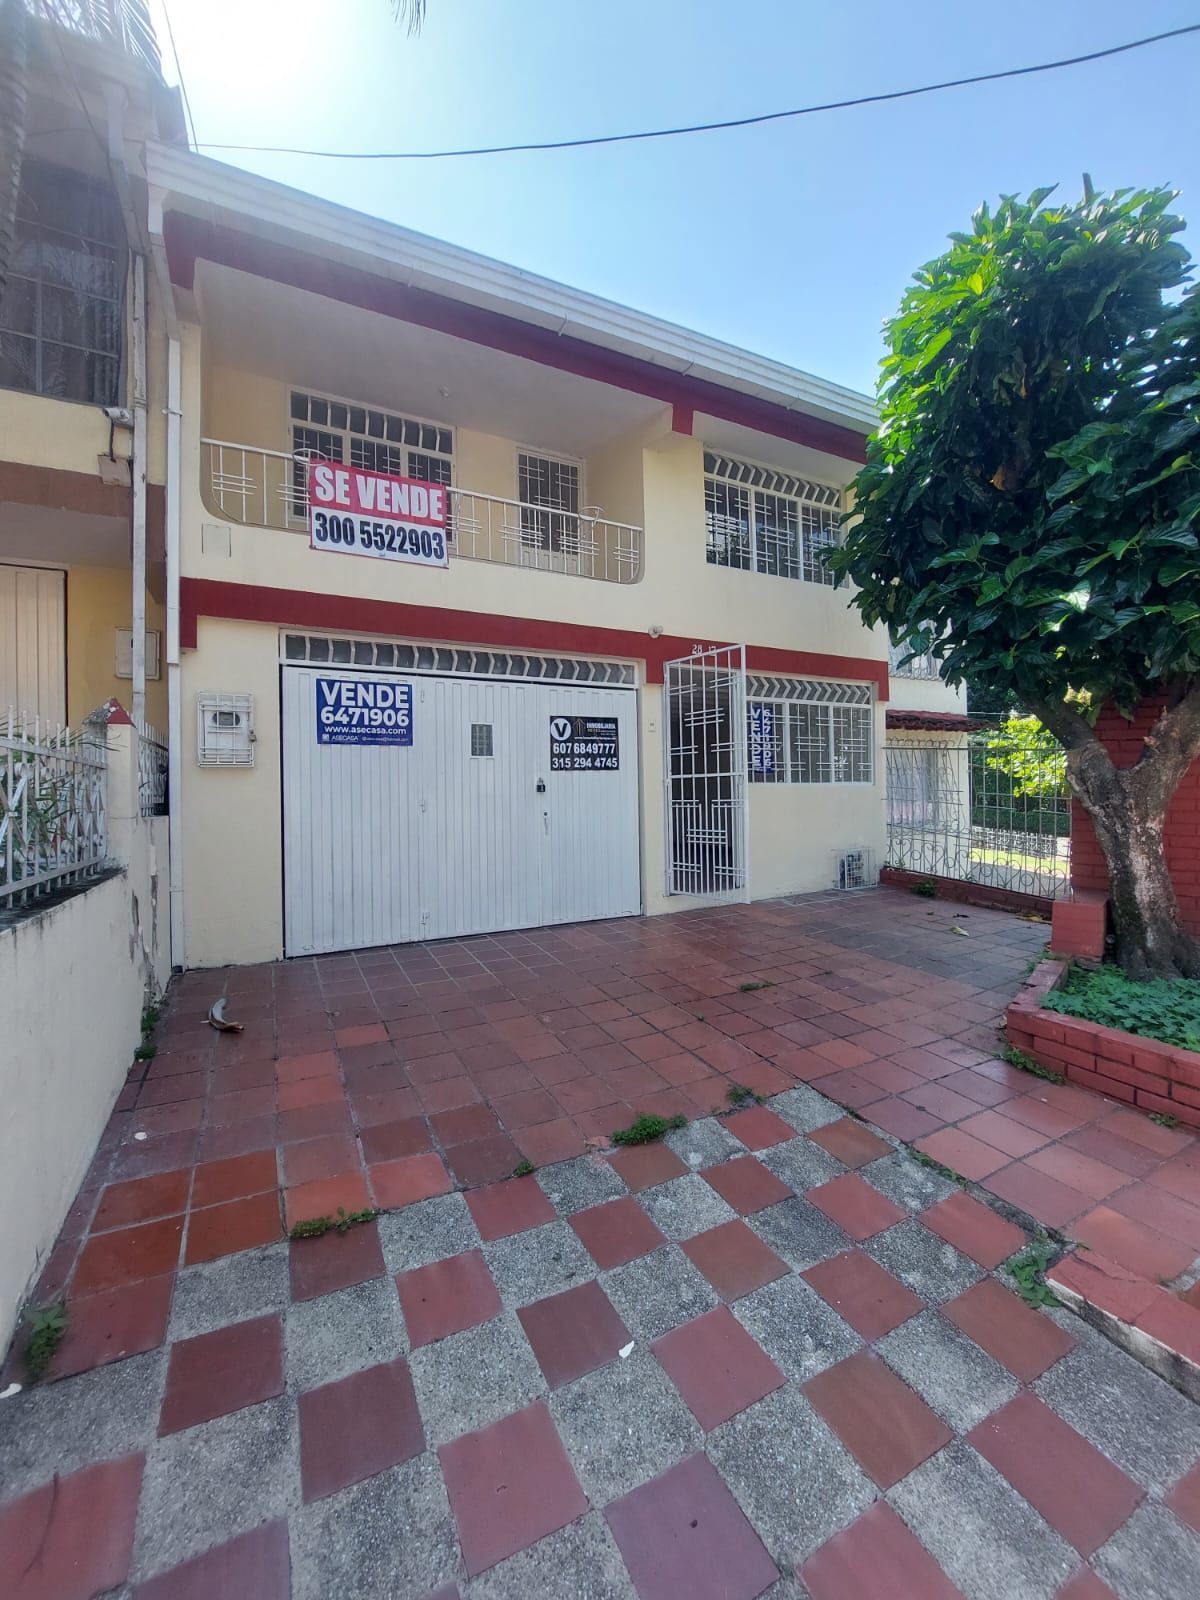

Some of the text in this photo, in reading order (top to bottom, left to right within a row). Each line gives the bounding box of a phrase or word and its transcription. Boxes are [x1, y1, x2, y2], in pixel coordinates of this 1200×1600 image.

[315, 466, 443, 521] SE VENDE
[315, 512, 445, 560] 300 5522903
[320, 681, 409, 709] VENDE
[320, 706, 410, 727] 6471906
[324, 726, 407, 735] www.asecasa.com
[553, 722, 568, 738] V
[751, 708, 762, 767] VENDE
[553, 743, 615, 754] 607 6849777
[552, 757, 618, 769] 315 294 4745
